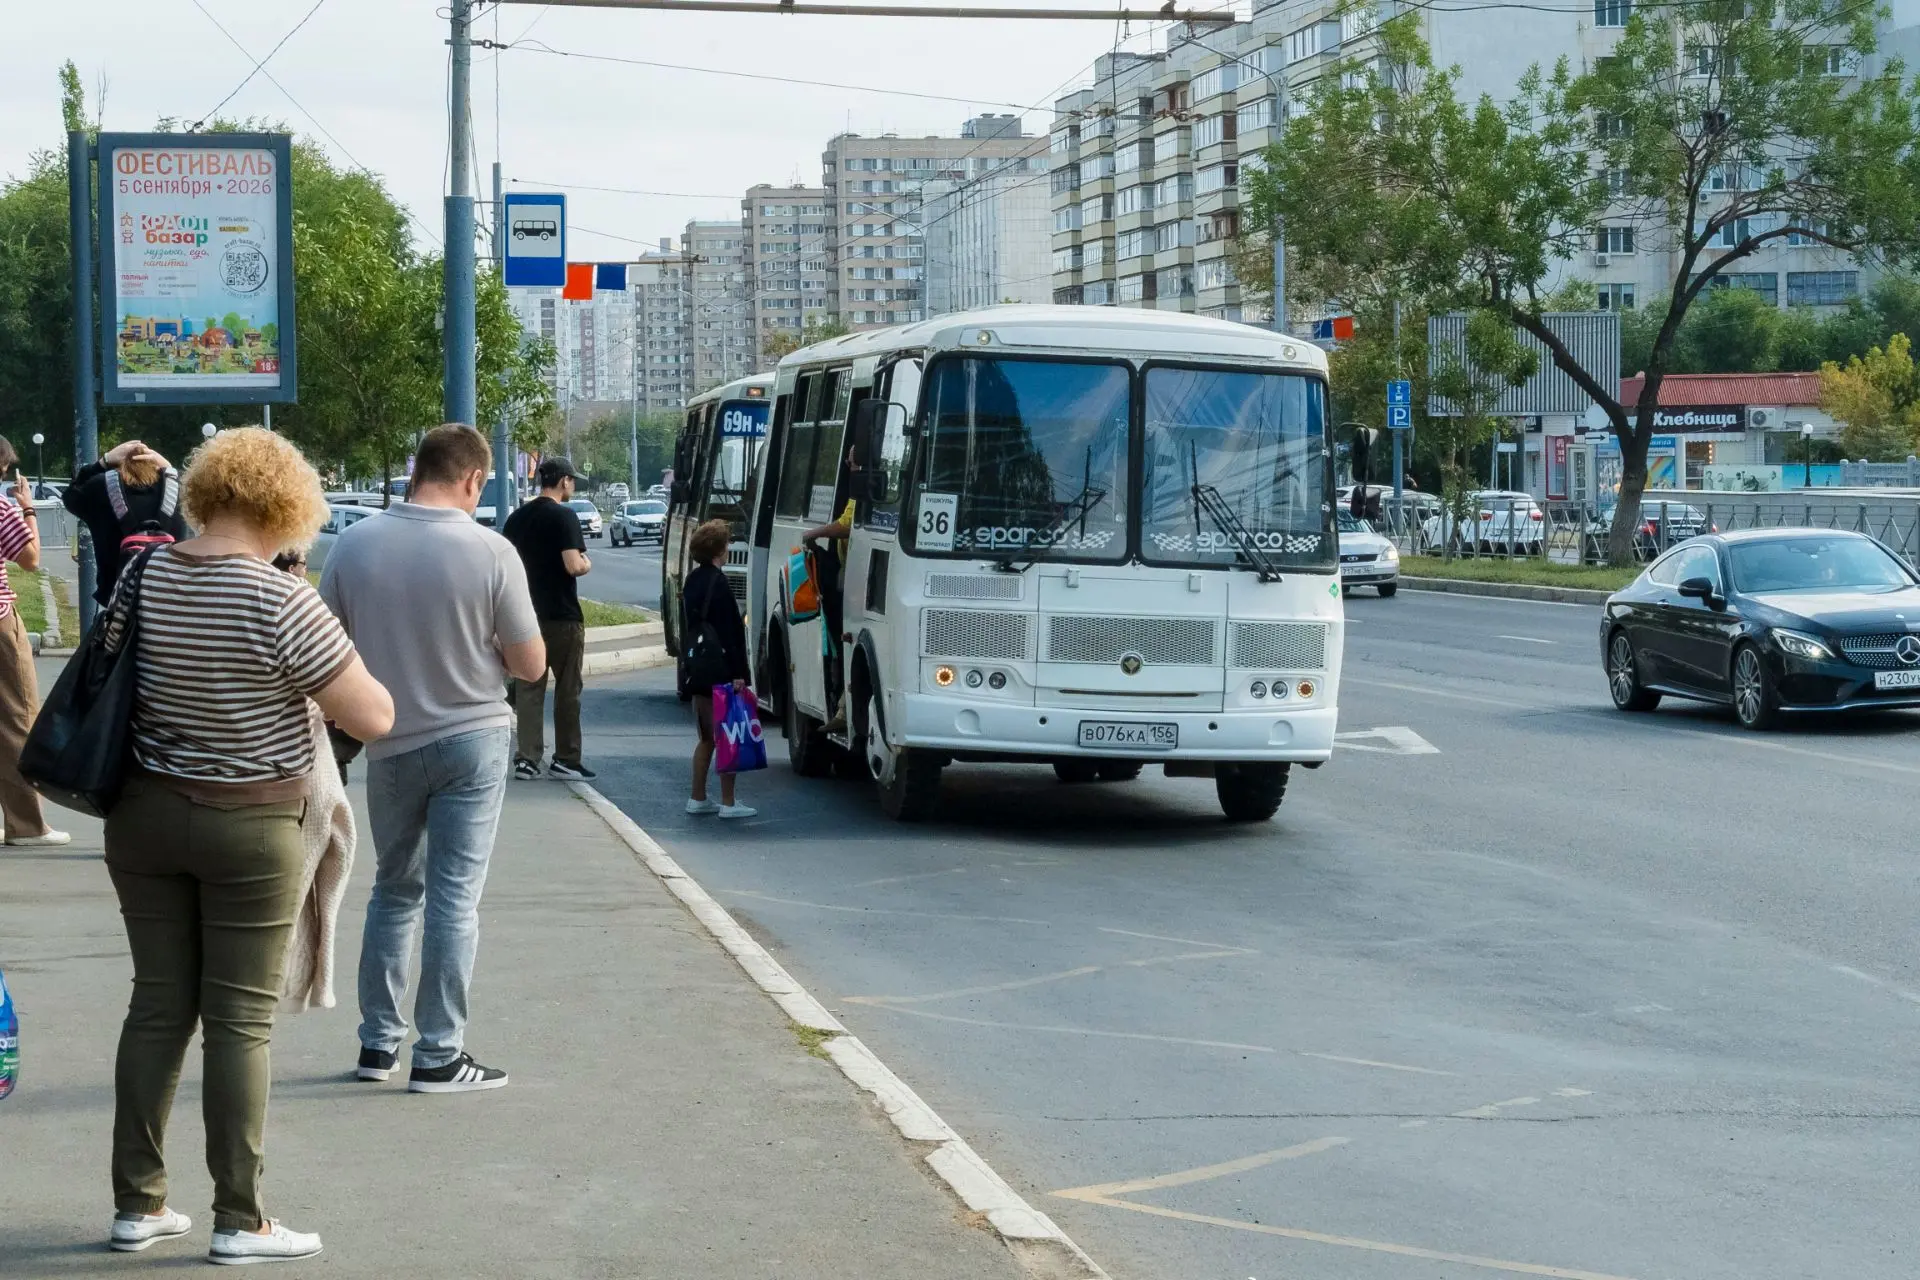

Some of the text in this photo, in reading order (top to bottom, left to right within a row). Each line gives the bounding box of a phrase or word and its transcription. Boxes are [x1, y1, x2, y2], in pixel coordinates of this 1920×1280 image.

[116, 152, 272, 175] ФЕСТИВАЛЬ
[119, 176, 272, 198] 5 сентября 2026
[141, 215, 208, 230] КРАФТ
[145, 229, 208, 247] базар
[260, 361, 277, 372] 18+
[1653, 411, 1737, 428] Хлебница
[921, 510, 949, 535] 36
[975, 526, 1069, 549] sparco
[1196, 531, 1283, 554] sparco
[1085, 725, 1174, 742] В076КА 156
